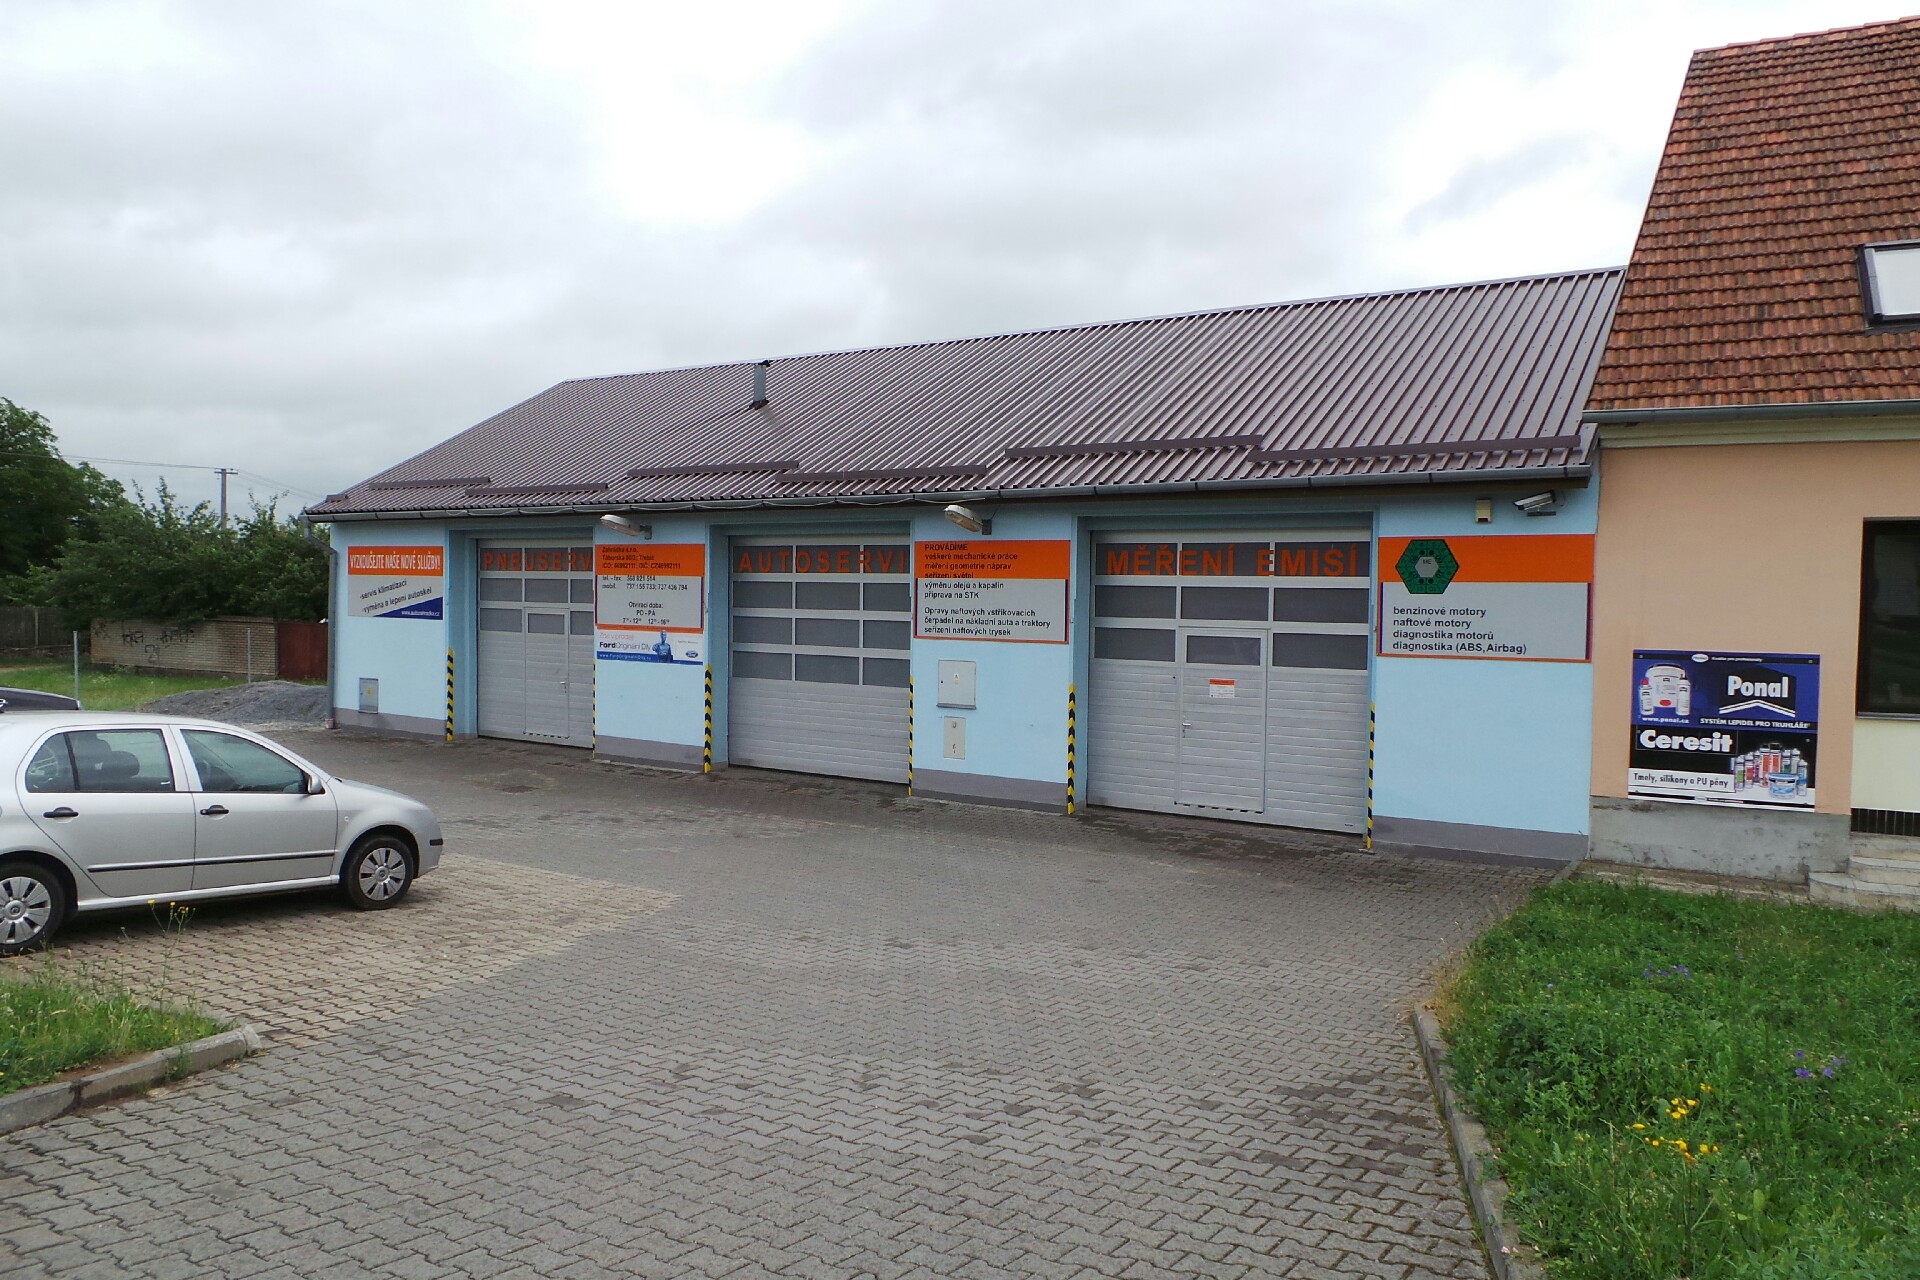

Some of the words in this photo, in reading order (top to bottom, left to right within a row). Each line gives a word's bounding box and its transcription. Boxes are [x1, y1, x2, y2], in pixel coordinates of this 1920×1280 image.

[350, 550, 384, 569] VYZKOUŠEJTE
[385, 551, 399, 569] NAŠE
[401, 550, 415, 570] NOVÉ
[417, 551, 440, 570] SLUŽBY!
[738, 550, 906, 573] AUTOSERVI
[1107, 544, 1234, 576] MĚŘENÍ
[1256, 544, 1358, 577] EMISÍ
[987, 562, 1012, 570] náprav
[978, 582, 1004, 590] kapalin
[924, 607, 949, 615] Opravy
[951, 608, 985, 617] naftových
[1449, 608, 1487, 618] motory
[924, 616, 953, 625] čerpadel
[965, 617, 996, 625] nákladní
[1021, 620, 1050, 628] traktory
[1393, 618, 1431, 627] naftové
[1434, 619, 1472, 629] motory
[952, 627, 987, 635] naftových
[1393, 630, 1453, 640] diagnostika
[1456, 630, 1494, 640] motorů
[1392, 641, 1453, 652] diagnostika
[1727, 675, 1789, 697] Ponal
[1642, 716, 1689, 724] www.ponal.cz
[1728, 719, 1753, 727] LEPIDEL
[1772, 721, 1808, 729] TRUHLÁŘE
[1639, 730, 1733, 752] Ceresit
[1660, 774, 1688, 785] silikony
[1709, 778, 1729, 788] pěny
